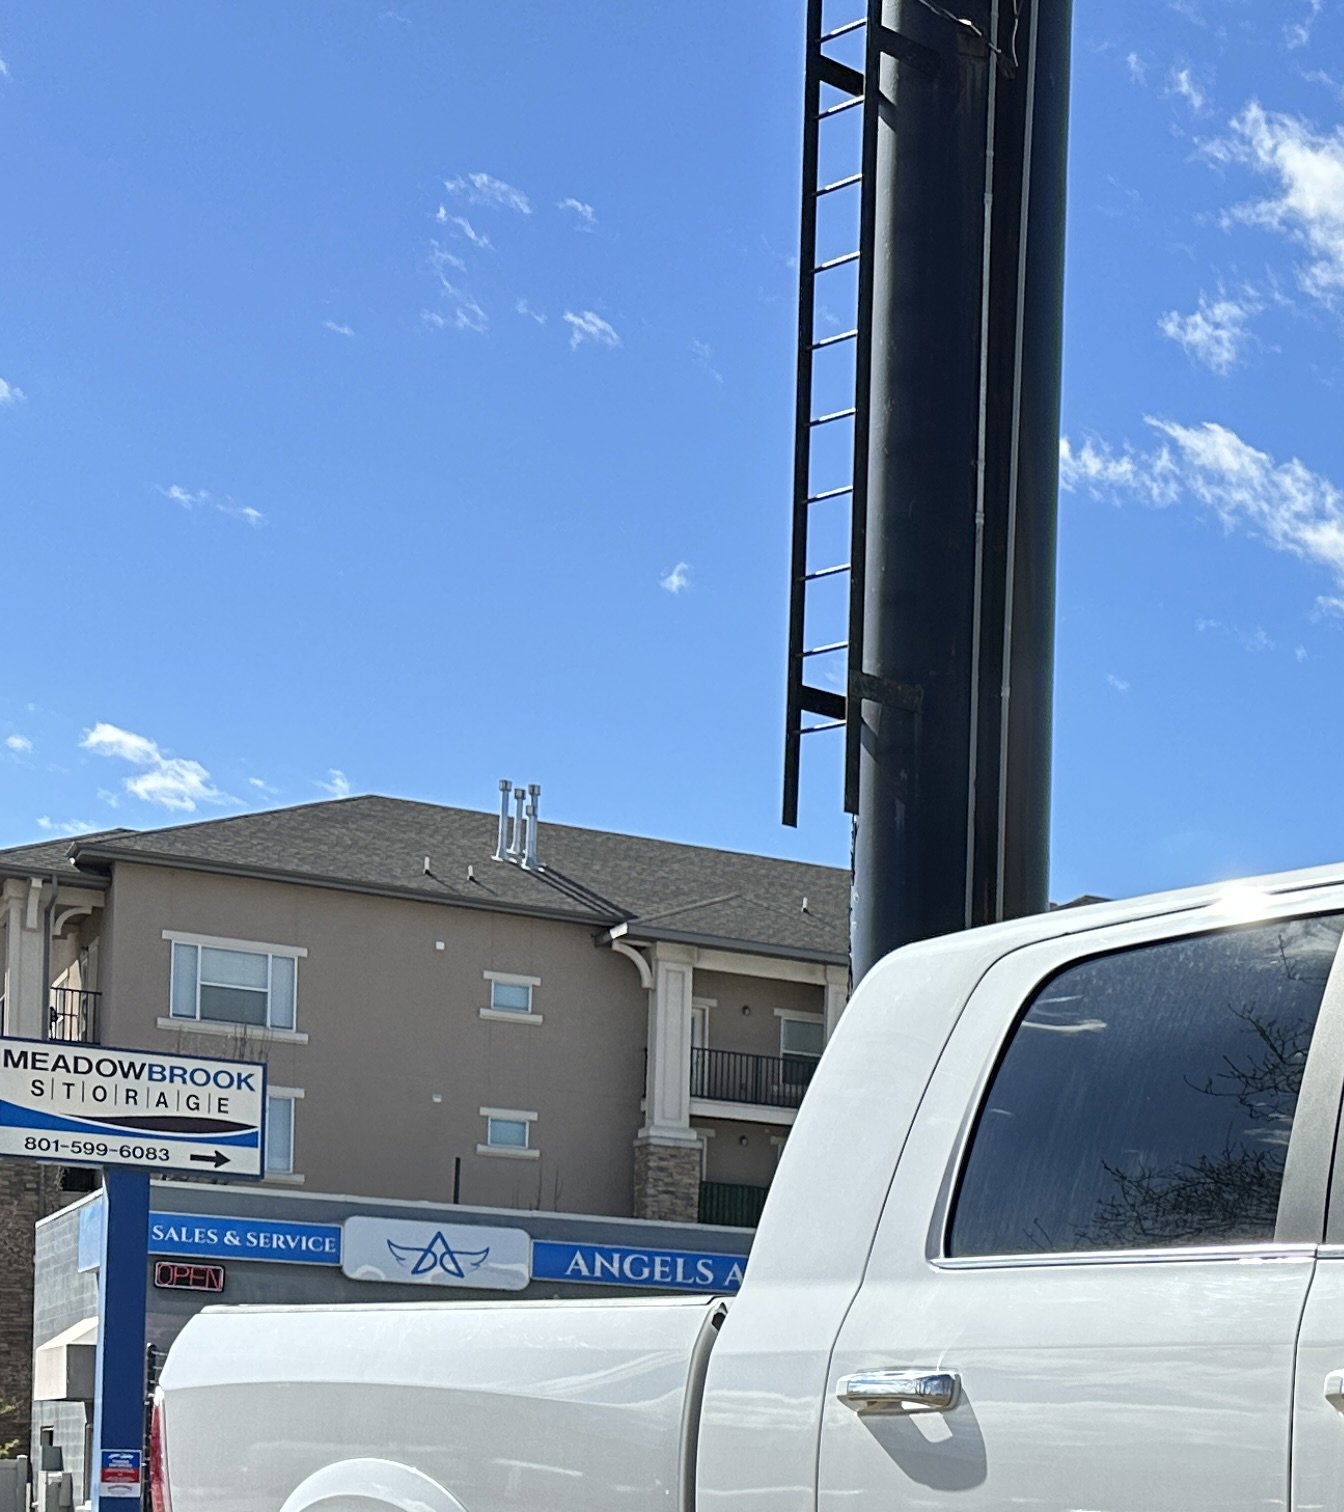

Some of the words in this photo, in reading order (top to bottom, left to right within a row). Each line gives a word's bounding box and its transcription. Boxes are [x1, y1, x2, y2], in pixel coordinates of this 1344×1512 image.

[3, 1050, 256, 1091] MEADOWBROOK
[24, 1137, 170, 1161] 801-599-6083
[152, 1225, 218, 1244] SALES
[224, 1231, 241, 1246] &
[246, 1231, 336, 1253] SERVICE
[158, 1263, 222, 1289] OPEN
[565, 1250, 713, 1285] ANGELS
